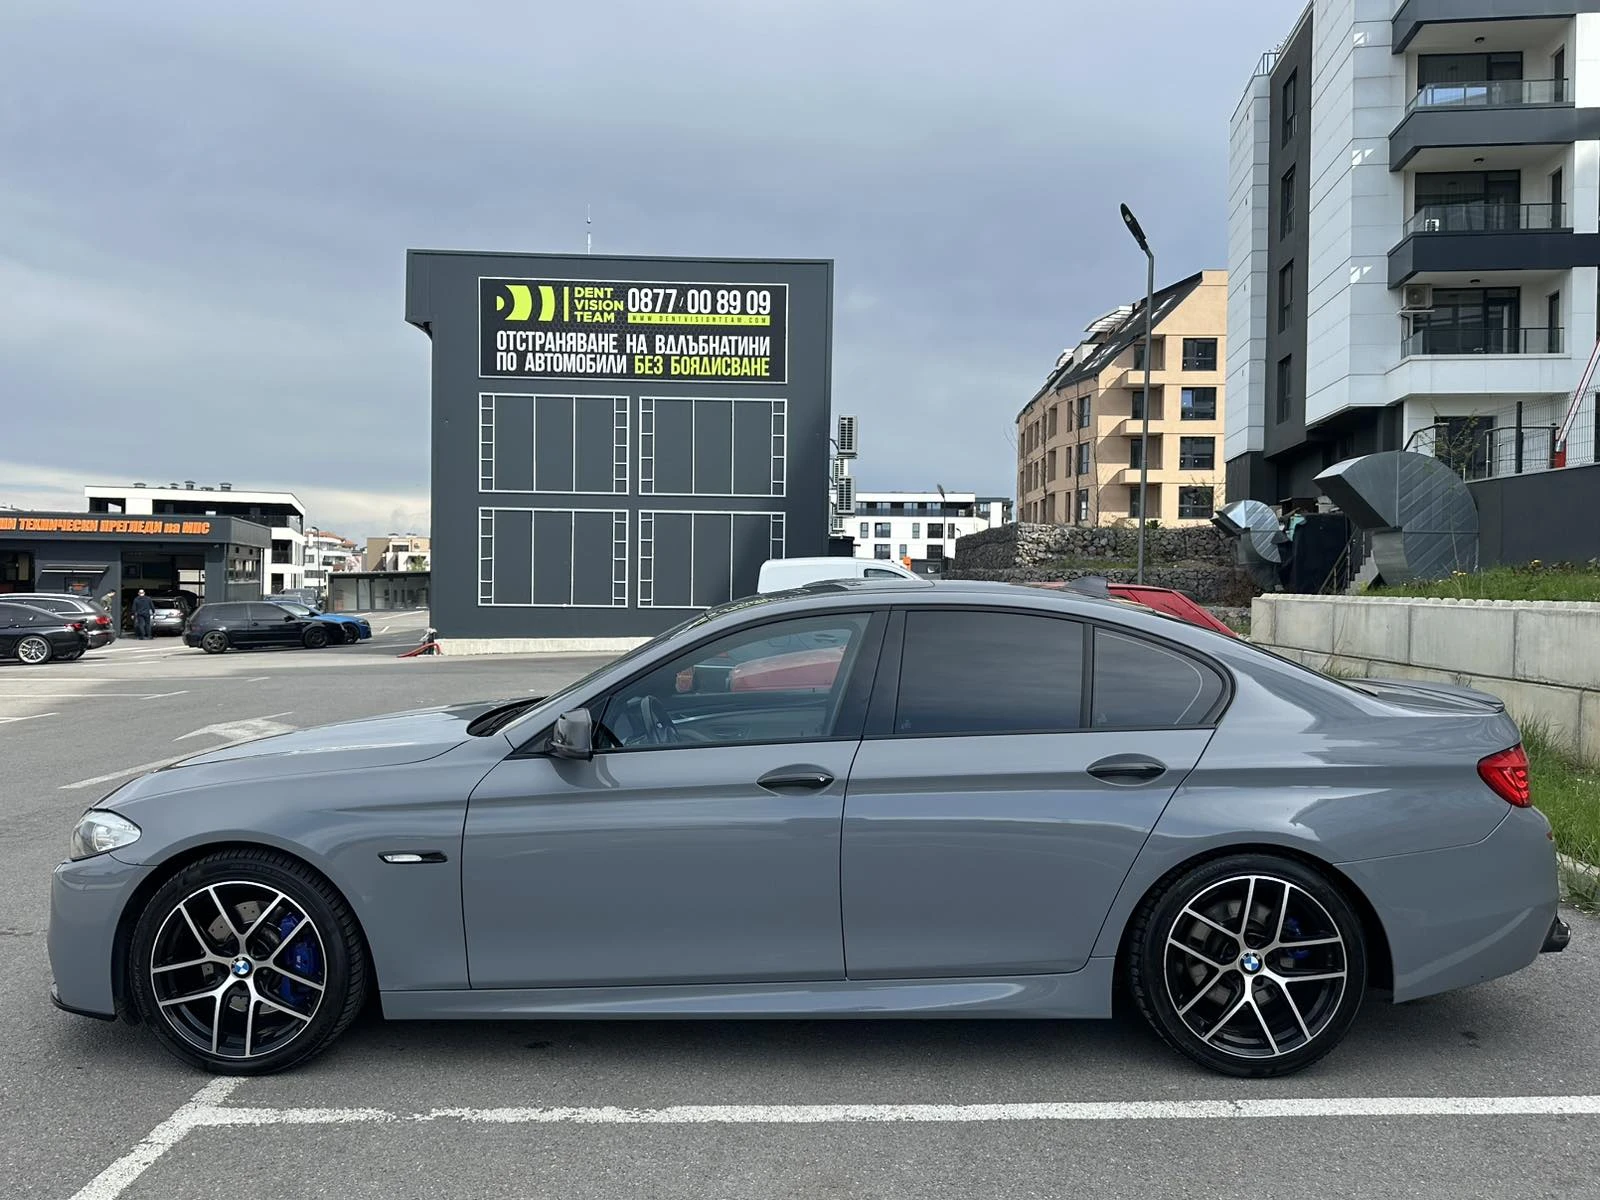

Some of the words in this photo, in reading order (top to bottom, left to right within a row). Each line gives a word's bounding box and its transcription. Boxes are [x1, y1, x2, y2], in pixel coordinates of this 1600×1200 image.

[573, 286, 613, 299] DENT
[573, 299, 624, 312] VISION
[627, 287, 678, 314] 0877
[686, 289, 712, 314] 00
[716, 289, 742, 314] 89
[746, 290, 771, 315] 09
[573, 312, 615, 325] TEAM
[632, 315, 767, 324] WWW.DENTVISIONTEAM.COM
[496, 330, 618, 354] ОТСТРАНЯВАНЕ
[626, 333, 648, 355] НА
[655, 335, 770, 357] ВДЛЪБНАТИНИ
[496, 352, 517, 372] ПО
[524, 354, 627, 374] АВТОМОБИЛИ
[634, 356, 664, 375] БЕЗ
[670, 356, 770, 377] БОЯДИСВАНЕ
